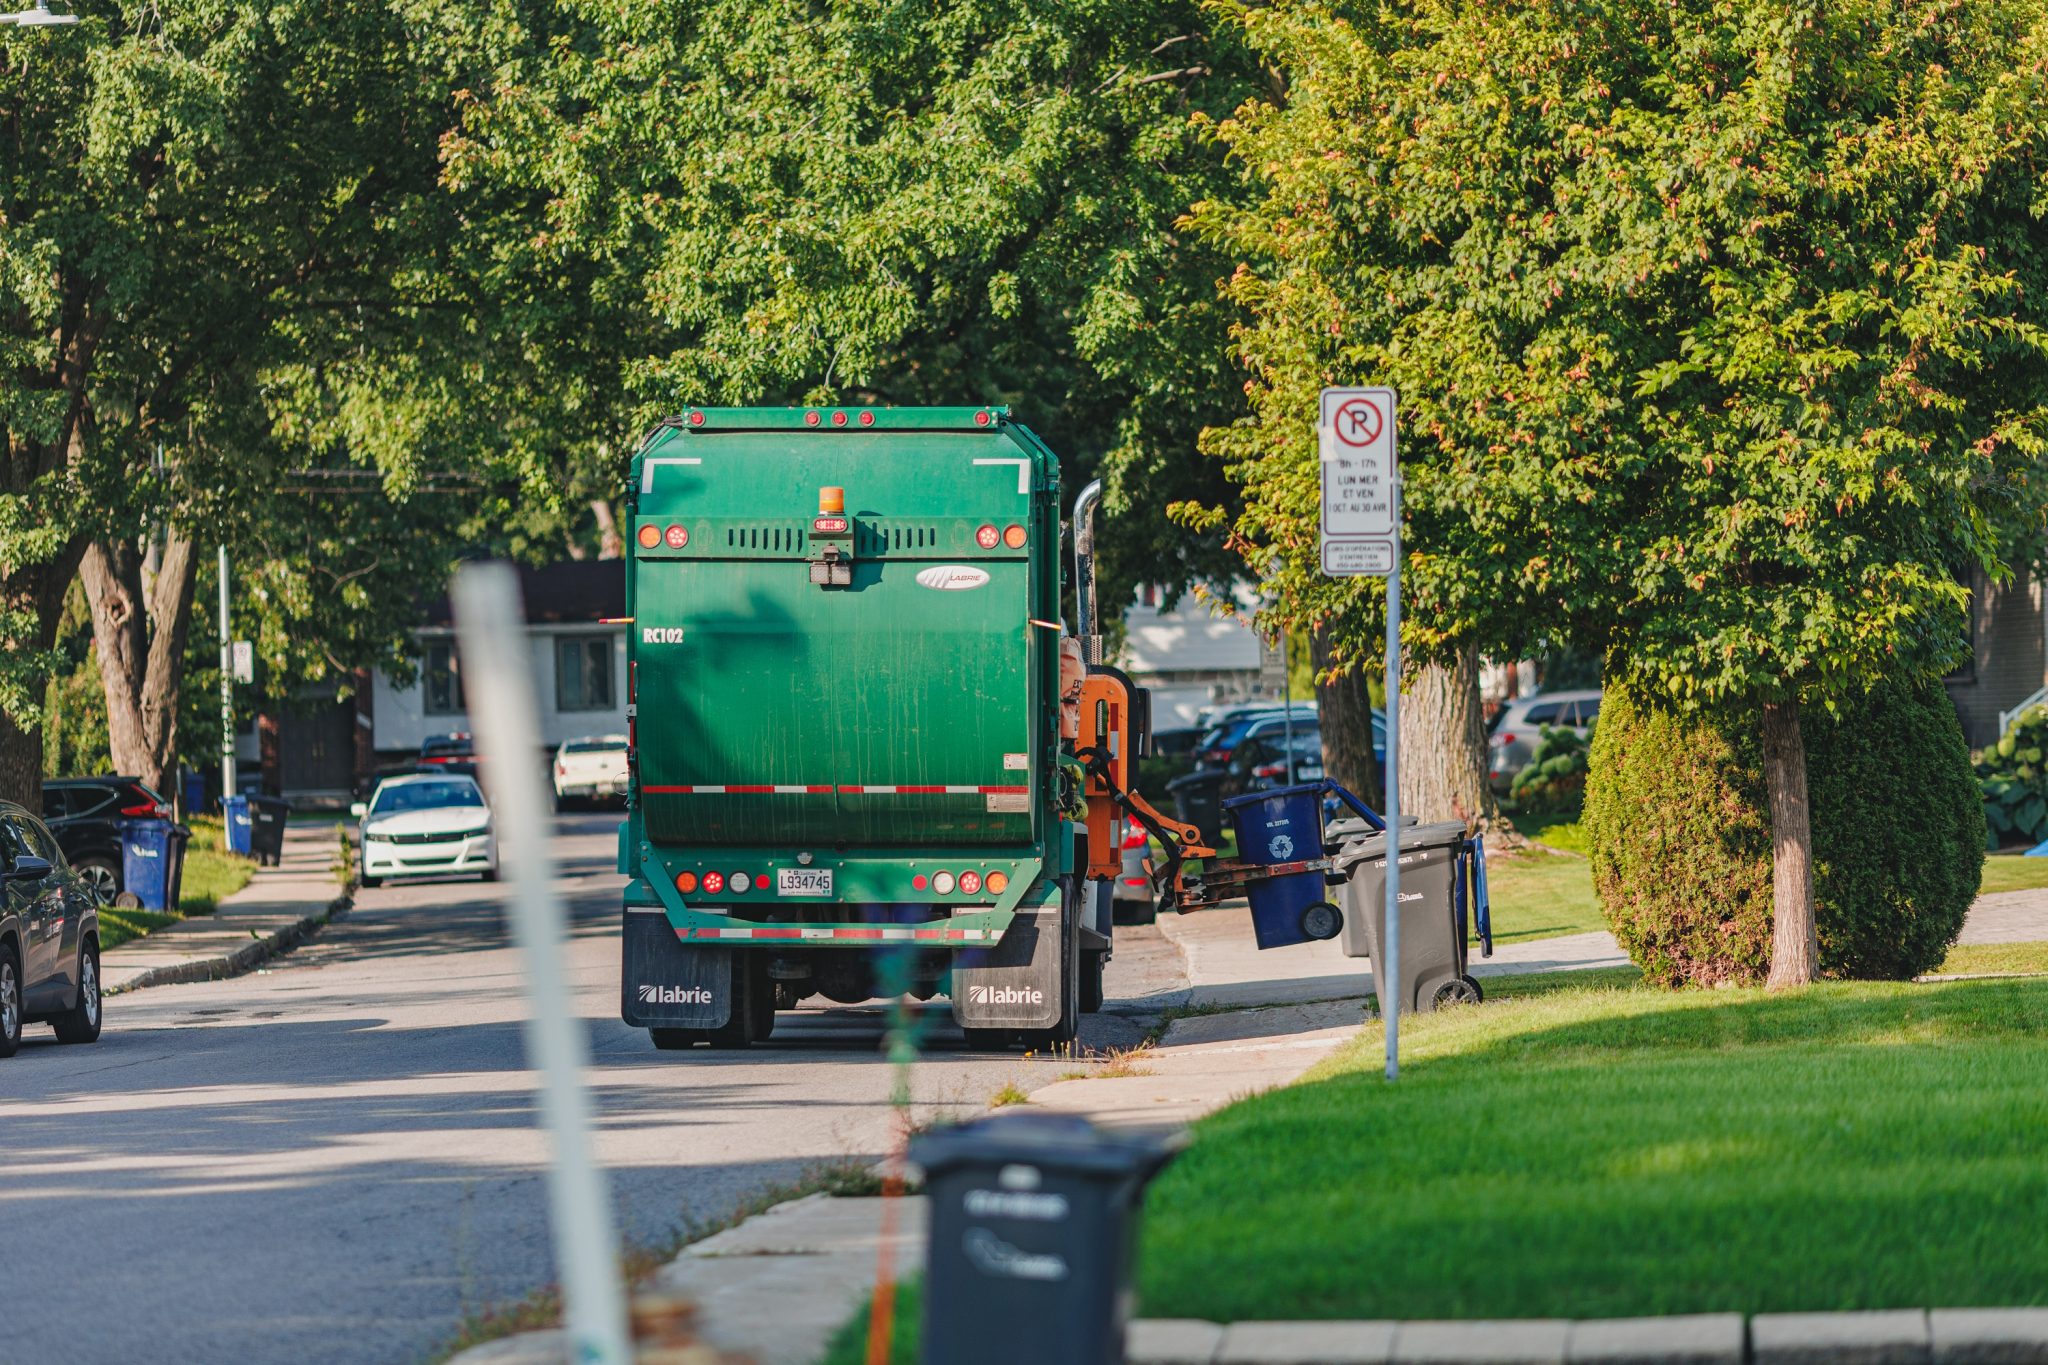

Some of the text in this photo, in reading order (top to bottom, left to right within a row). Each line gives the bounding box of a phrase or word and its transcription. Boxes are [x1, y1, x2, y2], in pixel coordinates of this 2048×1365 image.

[1351, 410, 1367, 434] P
[1361, 458, 1376, 468] 17h
[1338, 475, 1378, 484] LUN MER
[1343, 488, 1374, 498] ET VEN
[1350, 503, 1360, 512] AU
[1362, 503, 1371, 512] 30
[643, 627, 684, 643] RC102
[780, 876, 830, 889] L934745
[658, 985, 712, 1003] labrie
[989, 985, 1043, 1004] labrie
